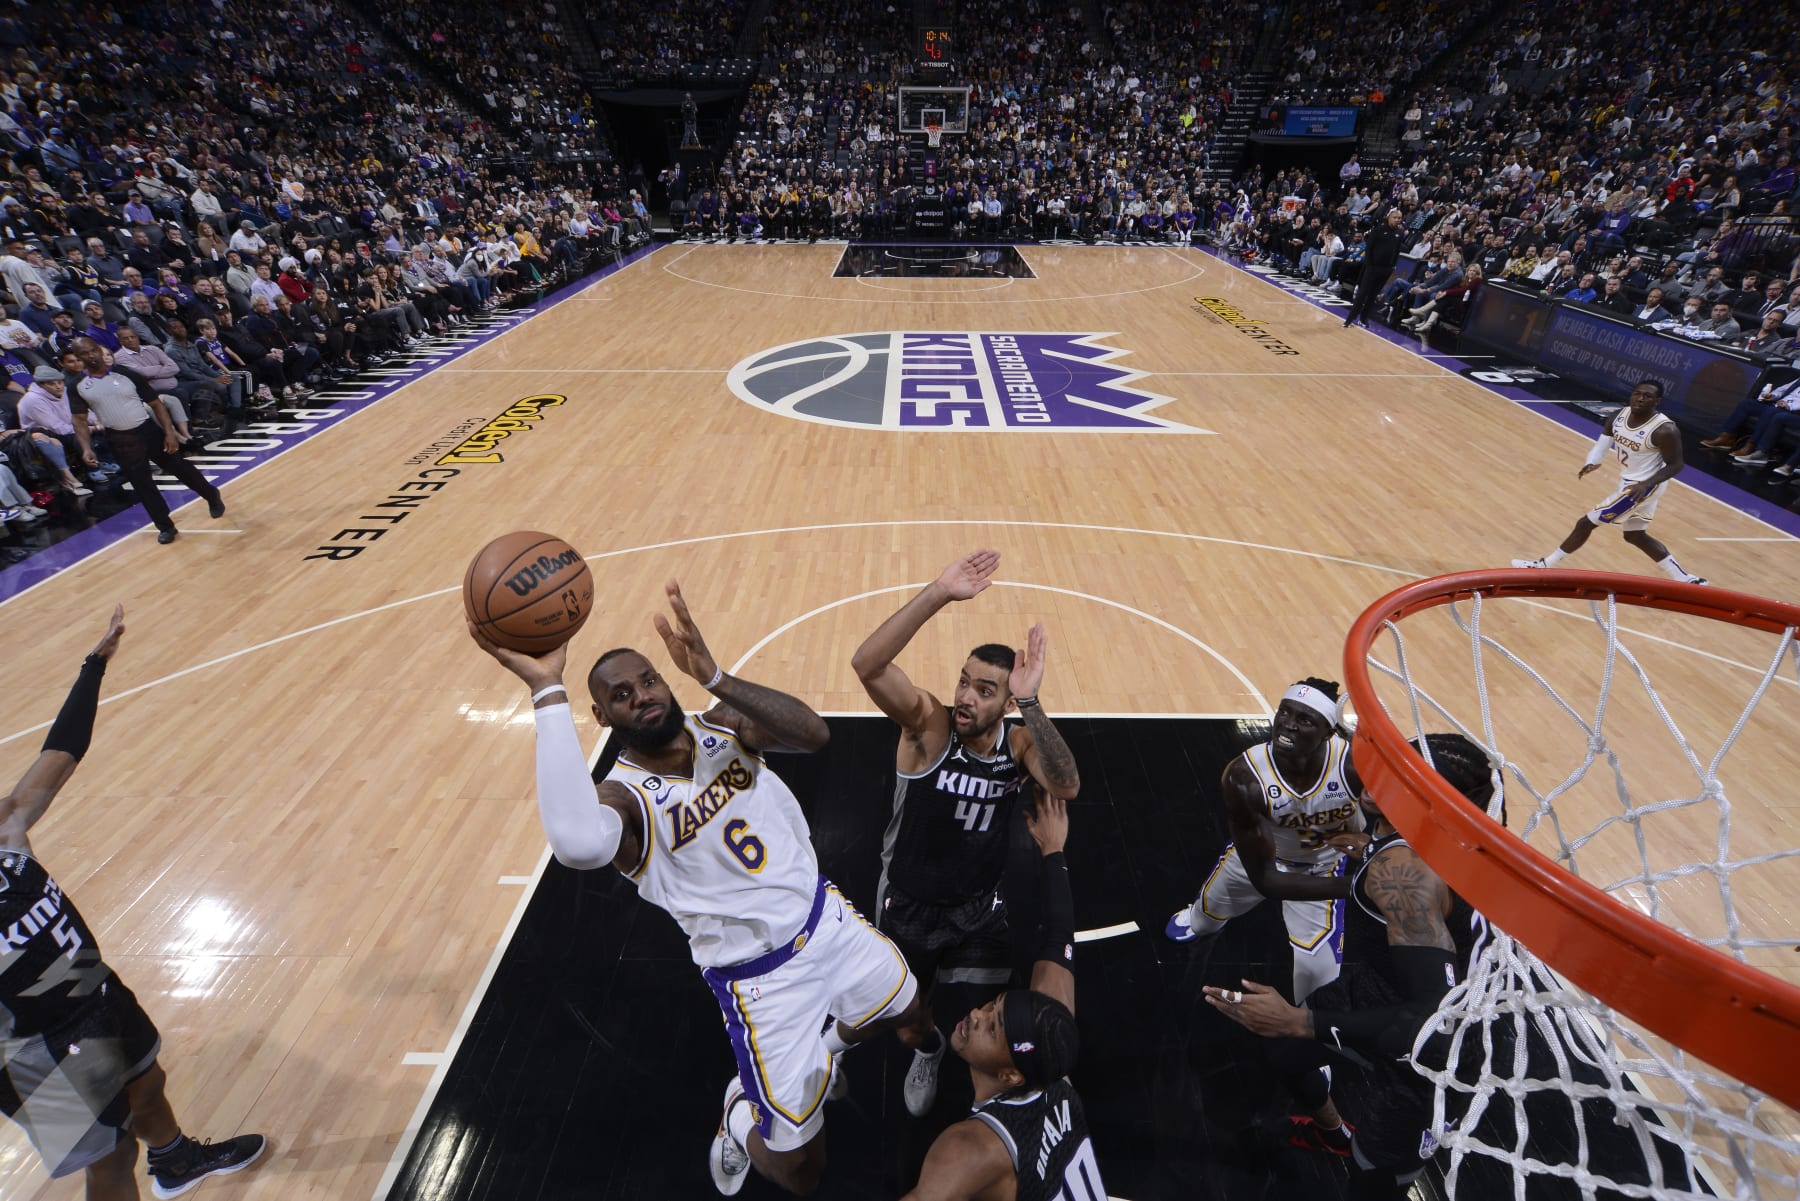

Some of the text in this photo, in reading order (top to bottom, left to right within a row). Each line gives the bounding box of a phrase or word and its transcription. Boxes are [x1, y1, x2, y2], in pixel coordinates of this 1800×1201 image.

[305, 308, 537, 400] SACRAMENTO
[1235, 324, 1301, 356] CENTER
[1551, 340, 1578, 361] SCORE
[1576, 348, 1591, 364] UP
[1590, 353, 1604, 371] TO
[1616, 363, 1644, 385] CASH
[1554, 315, 1598, 342] MEMBER
[1596, 328, 1626, 350] CASH
[1624, 337, 1684, 369] REWARDS
[900, 333, 991, 427] KINGS
[988, 334, 1053, 425] SACRAMENTO
[404, 417, 487, 466] Credit Union
[453, 393, 568, 453] Golden
[302, 468, 461, 562] CENTER
[503, 549, 582, 597] Wilson
[706, 738, 729, 758] bibigo
[645, 778, 660, 790] 6
[666, 757, 753, 854] LAKERS
[1269, 786, 1279, 798] 6
[1323, 791, 1347, 800] bibigo
[954, 800, 996, 832] 41
[1278, 802, 1357, 829] LAKERS
[722, 817, 768, 874] 6
[51, 913, 82, 961] 5
